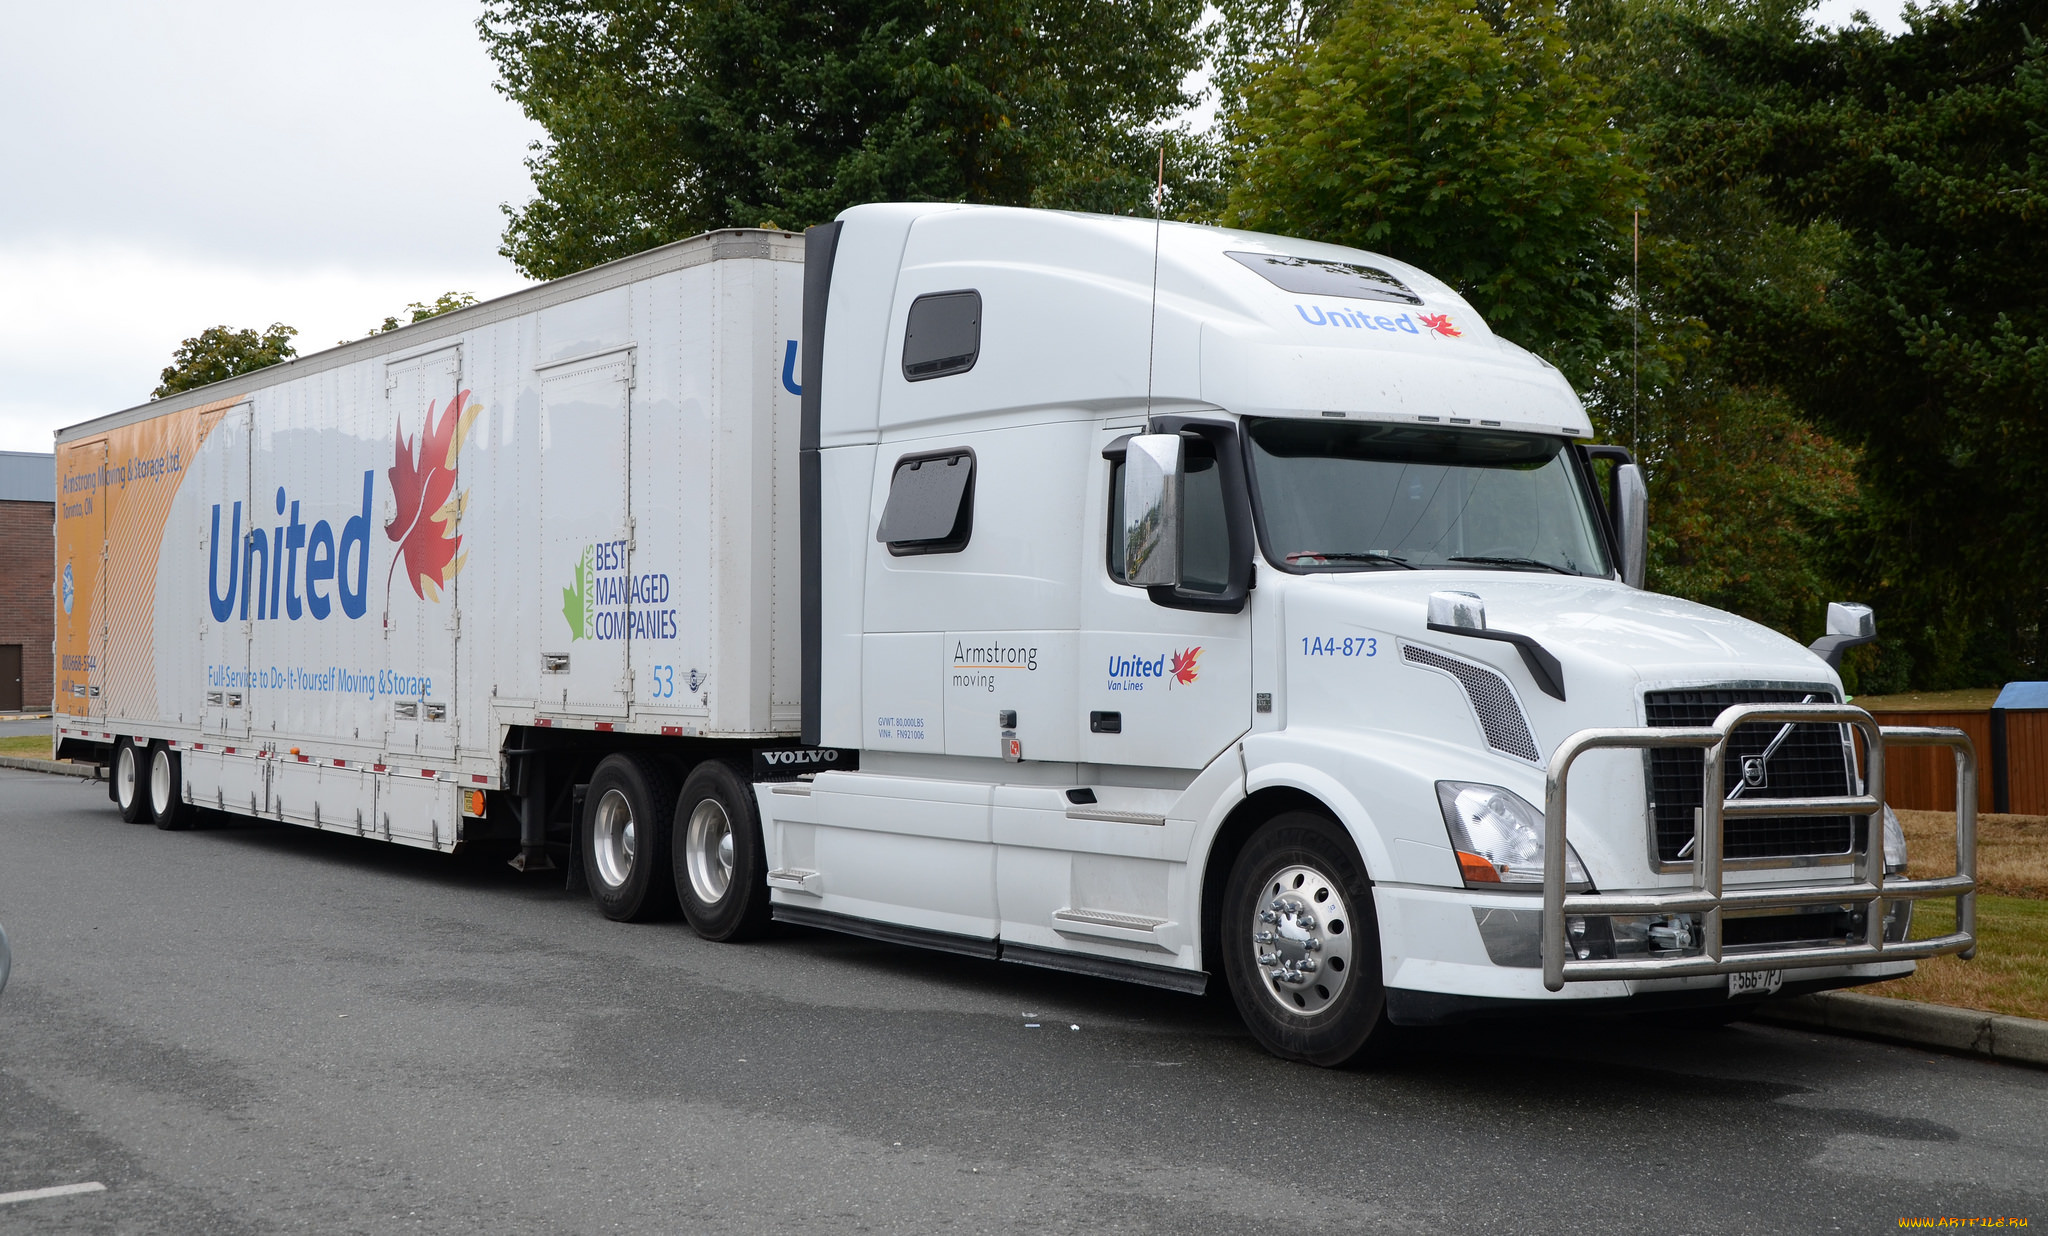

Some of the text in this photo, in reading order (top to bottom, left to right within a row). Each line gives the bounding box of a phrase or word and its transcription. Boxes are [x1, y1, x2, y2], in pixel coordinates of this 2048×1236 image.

[1295, 304, 1419, 334] United
[63, 472, 97, 495] Armstrong
[98, 462, 125, 489] Moving
[134, 456, 165, 482] Storage
[166, 446, 182, 473] Ltd.
[208, 469, 374, 623] United
[596, 540, 627, 571] BEST
[585, 543, 594, 641] CANADA'S
[596, 573, 669, 606] MANAGED
[595, 609, 677, 641] COMPANIES
[953, 639, 1038, 670] Armstrong
[1301, 636, 1378, 657] 1A4-873
[952, 670, 995, 692] moving
[1108, 653, 1165, 678] United
[208, 664, 257, 689] Full-Service
[259, 670, 269, 688] to
[270, 666, 336, 692] Do-It-Yourself
[337, 669, 376, 700] Moving
[387, 670, 432, 703] Storage
[652, 665, 674, 698] 53
[1107, 680, 1144, 691] Van Lines
[762, 750, 839, 765] VOLVO
